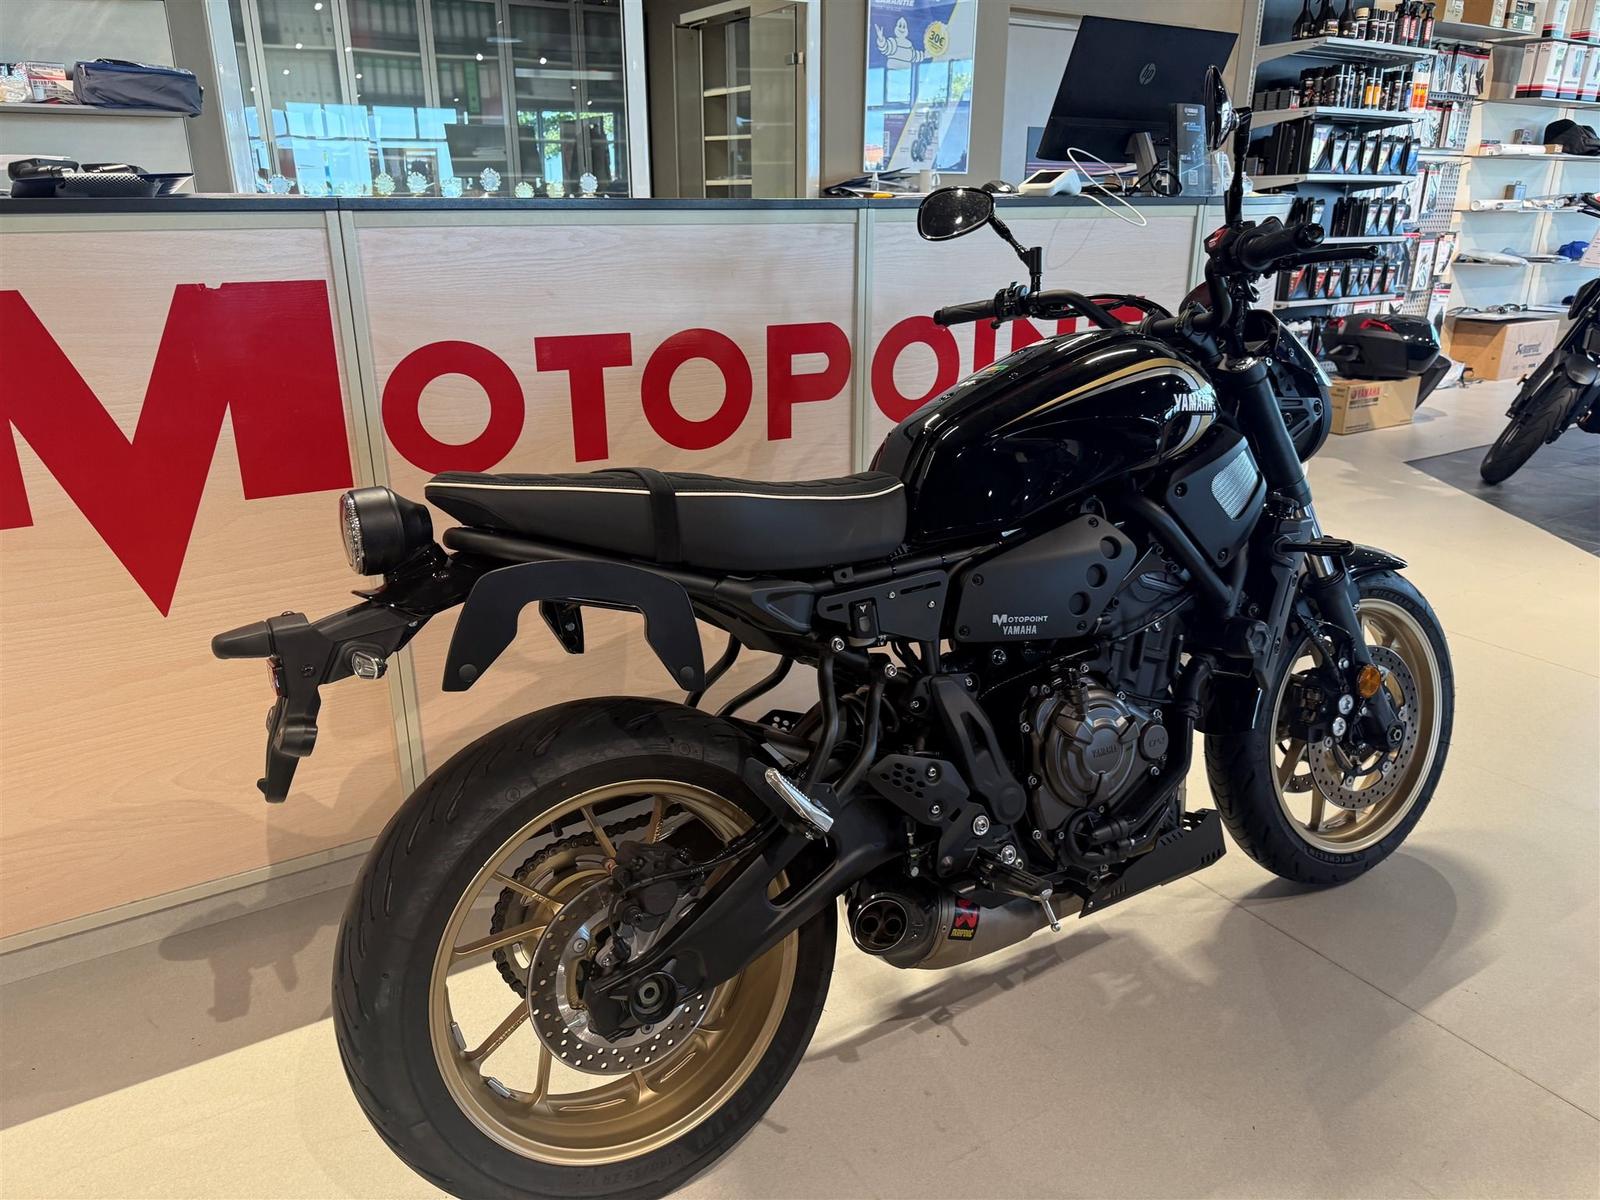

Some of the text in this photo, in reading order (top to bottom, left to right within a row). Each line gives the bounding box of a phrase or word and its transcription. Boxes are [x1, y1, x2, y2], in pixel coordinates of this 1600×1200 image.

[929, 30, 945, 47] 30€
[1140, 63, 1156, 85] hp
[0, 279, 1146, 617] MOTOPOI
[992, 614, 1048, 627] MOTOPOINT
[1002, 625, 1037, 635] YAMAHA
